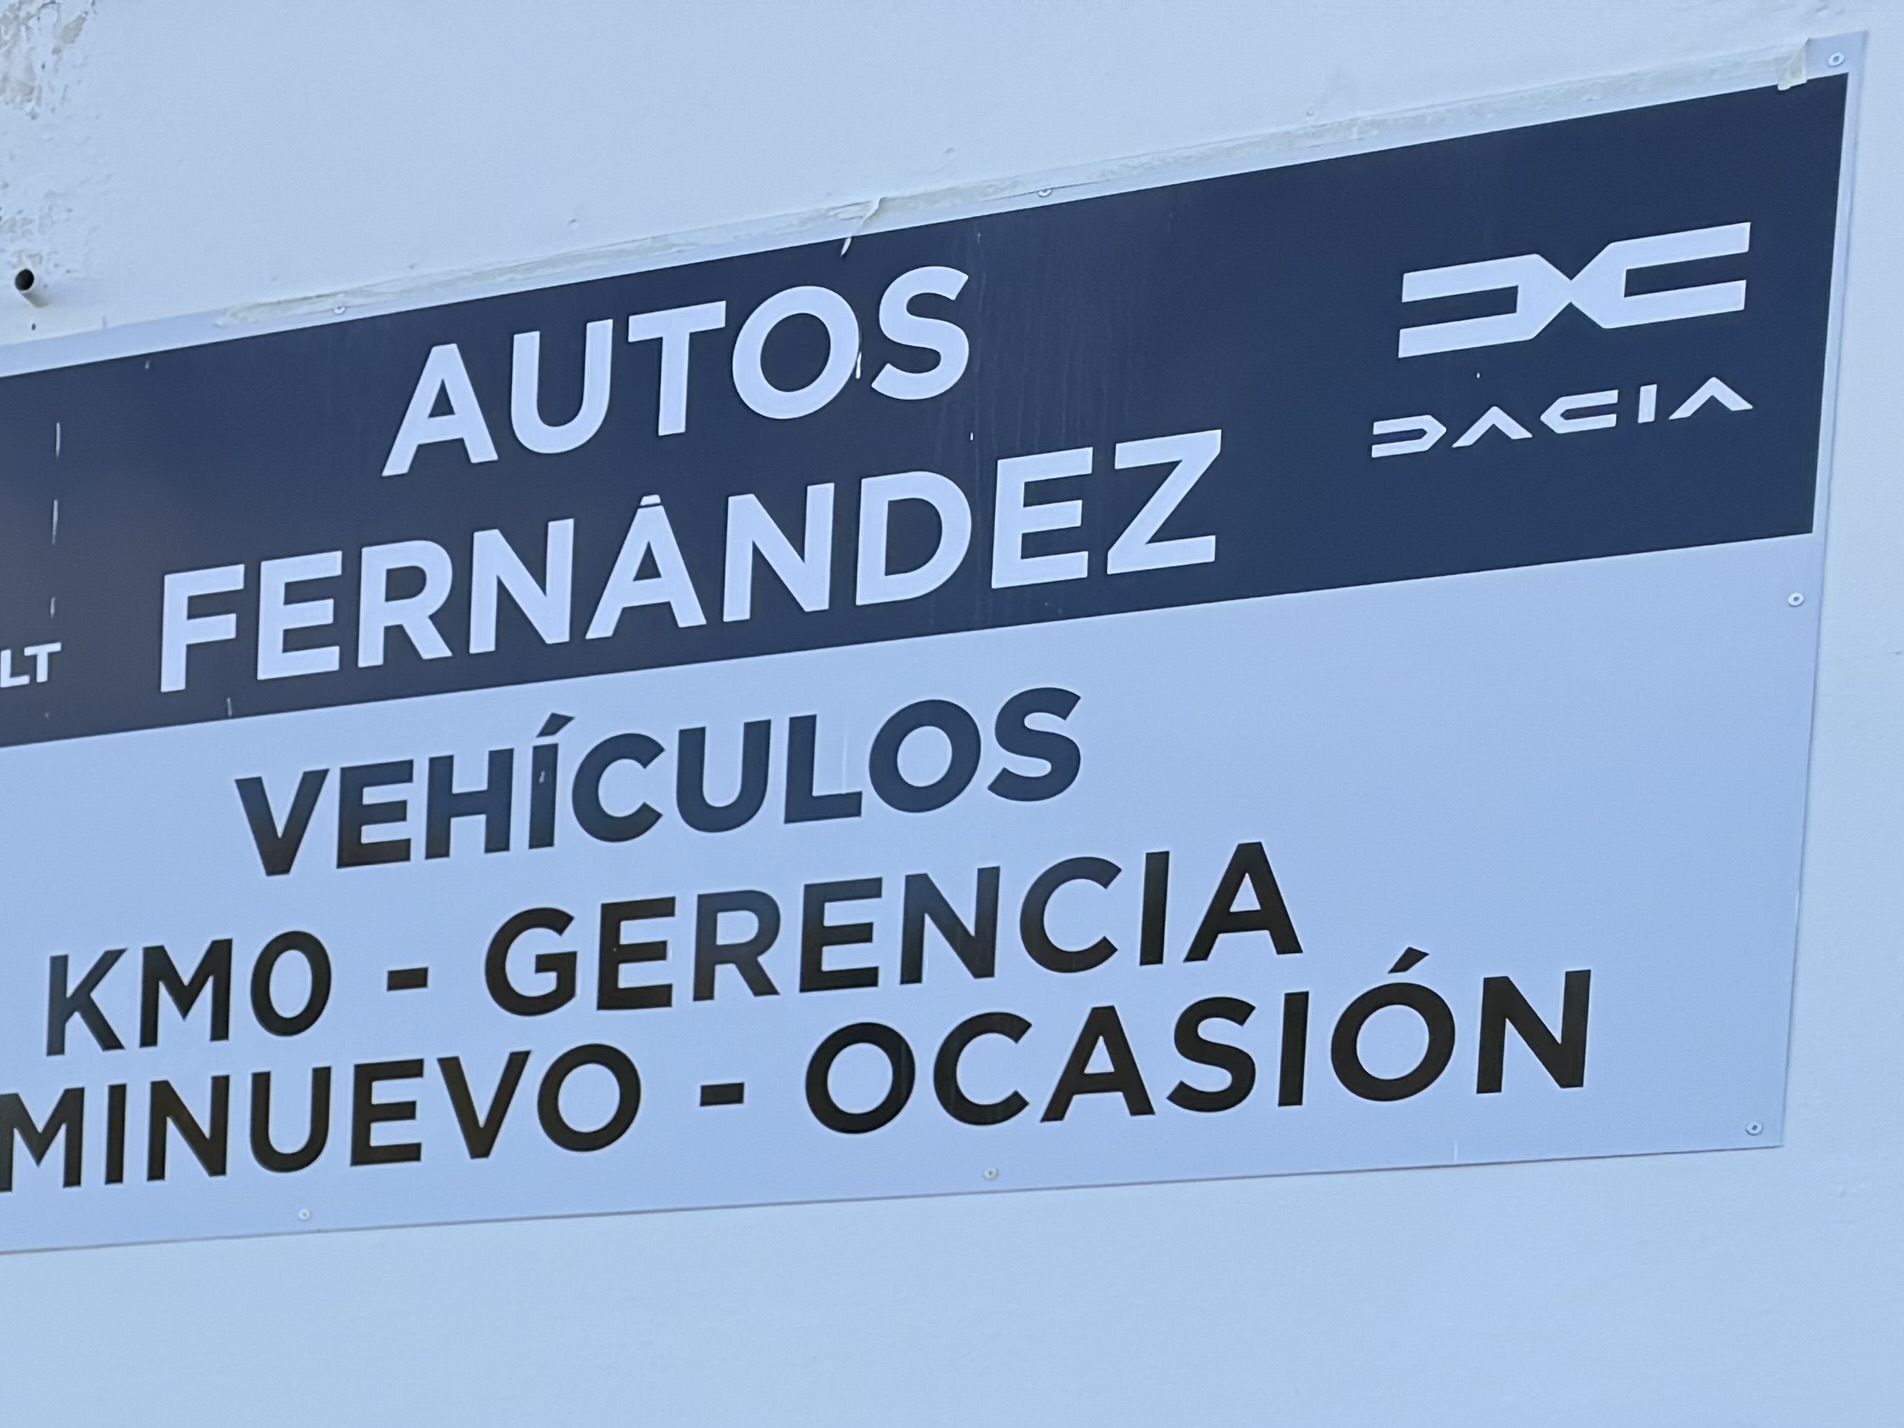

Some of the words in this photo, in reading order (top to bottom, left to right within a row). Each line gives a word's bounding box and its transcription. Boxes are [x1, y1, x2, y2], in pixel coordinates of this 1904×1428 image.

[382, 266, 969, 476] AUTOS
[1372, 377, 1753, 457] DACIA
[235, 688, 1081, 876] VEHÍCULOS
[485, 842, 1303, 1017] GERENCIA
[805, 947, 1591, 1134] OCASIÓN
